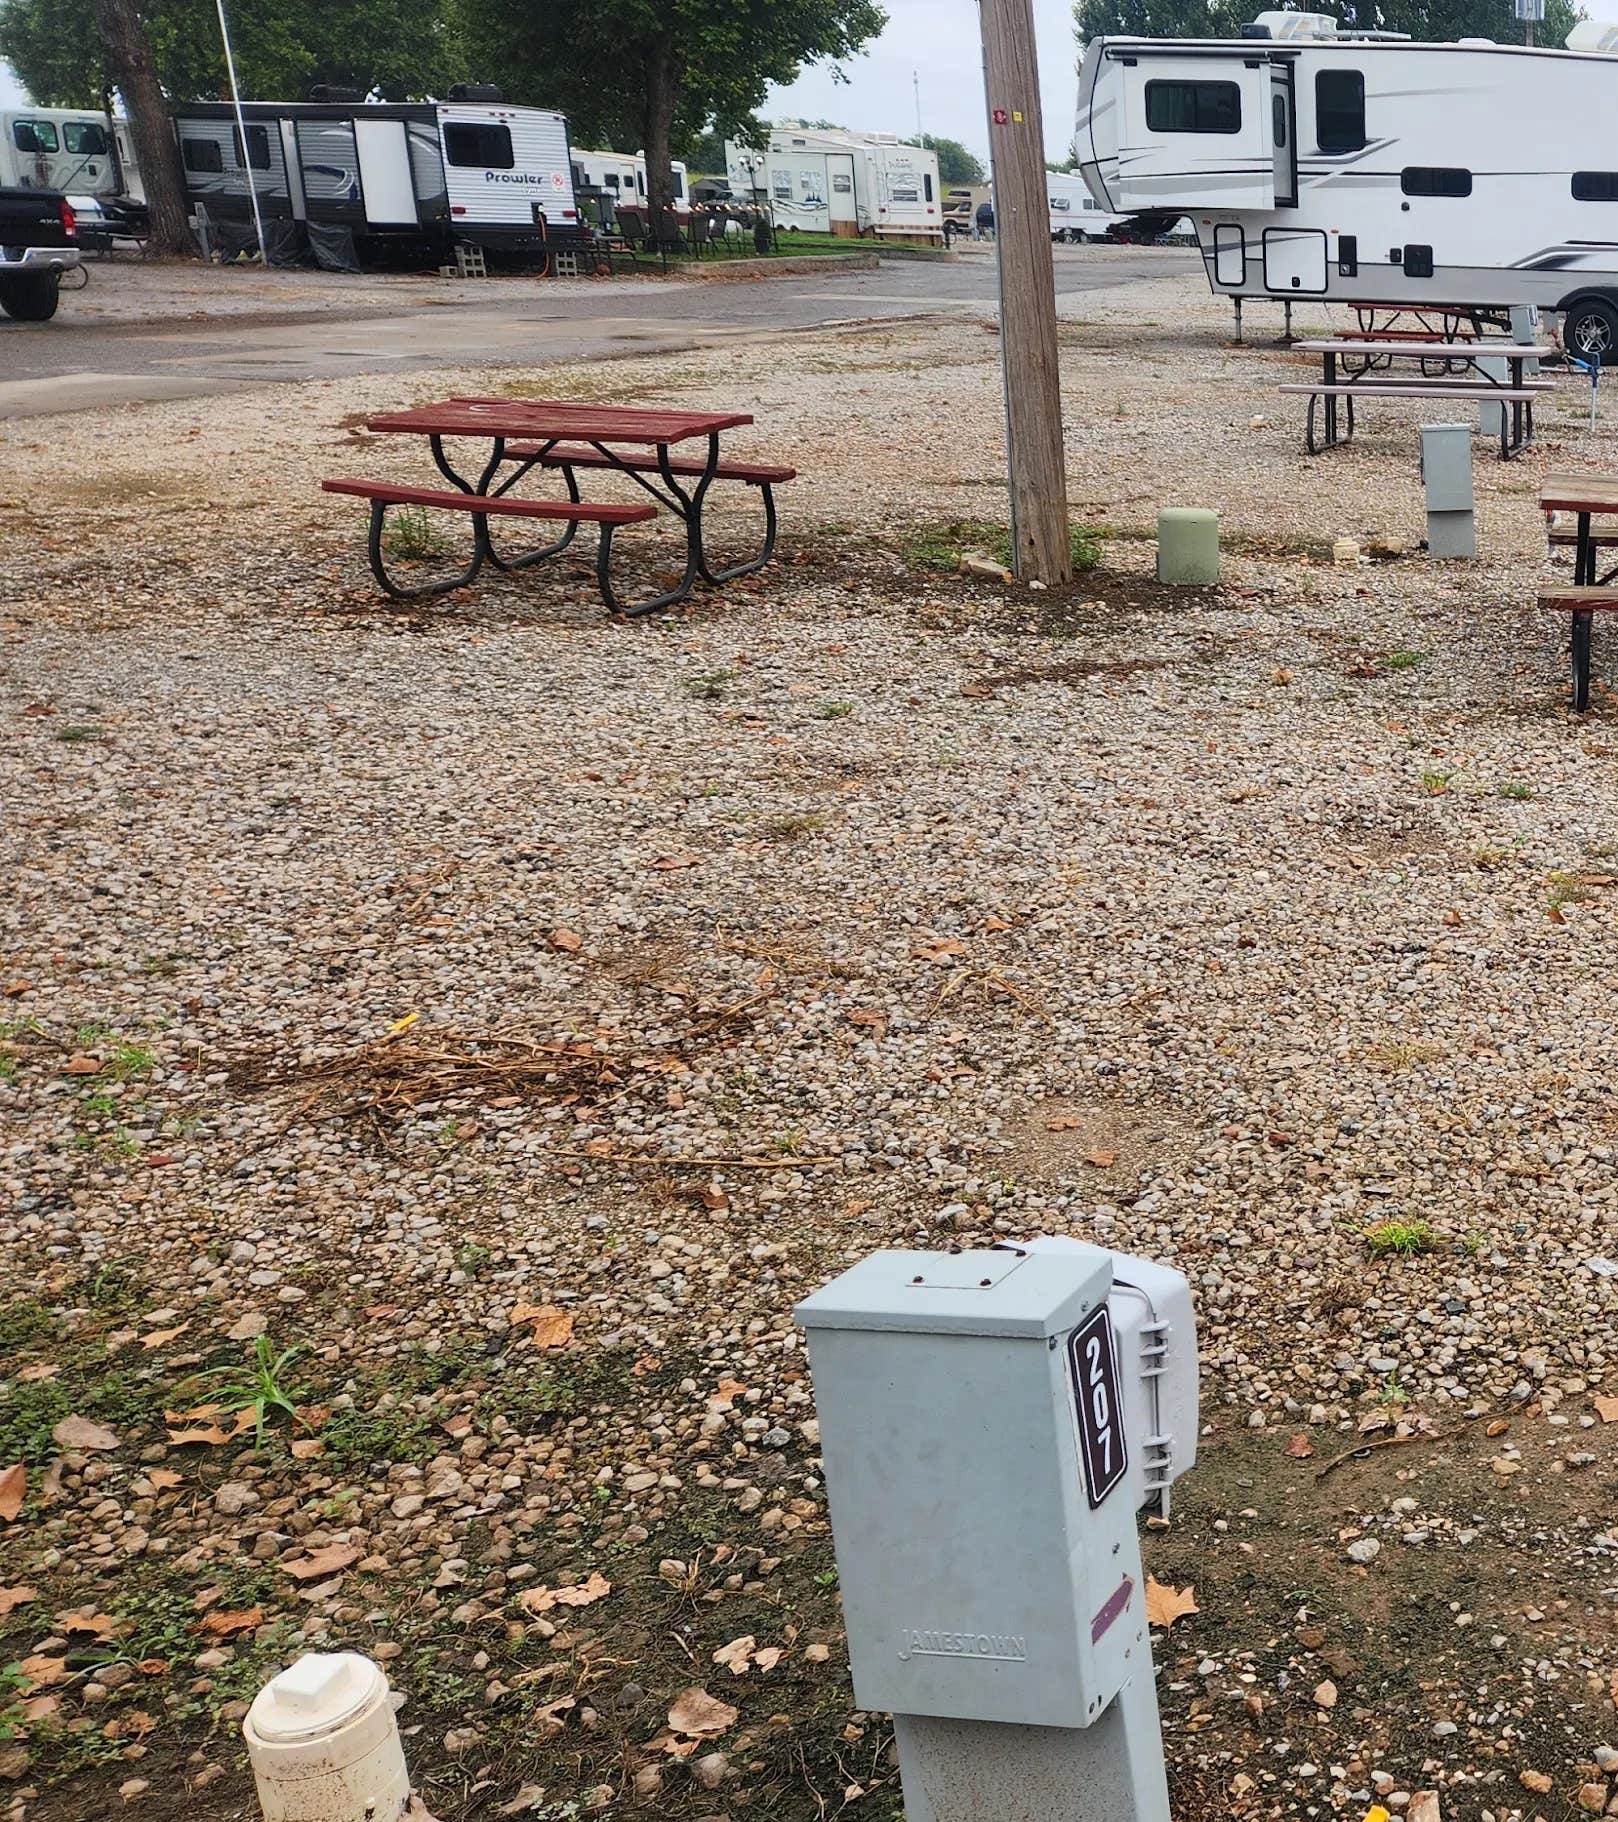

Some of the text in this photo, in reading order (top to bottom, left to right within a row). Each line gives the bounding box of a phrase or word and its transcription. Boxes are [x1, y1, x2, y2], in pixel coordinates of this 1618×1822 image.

[485, 171, 543, 184] Prowler
[1086, 1336, 1111, 1475] 207
[898, 1629, 1025, 1661] JAMESTOWN
